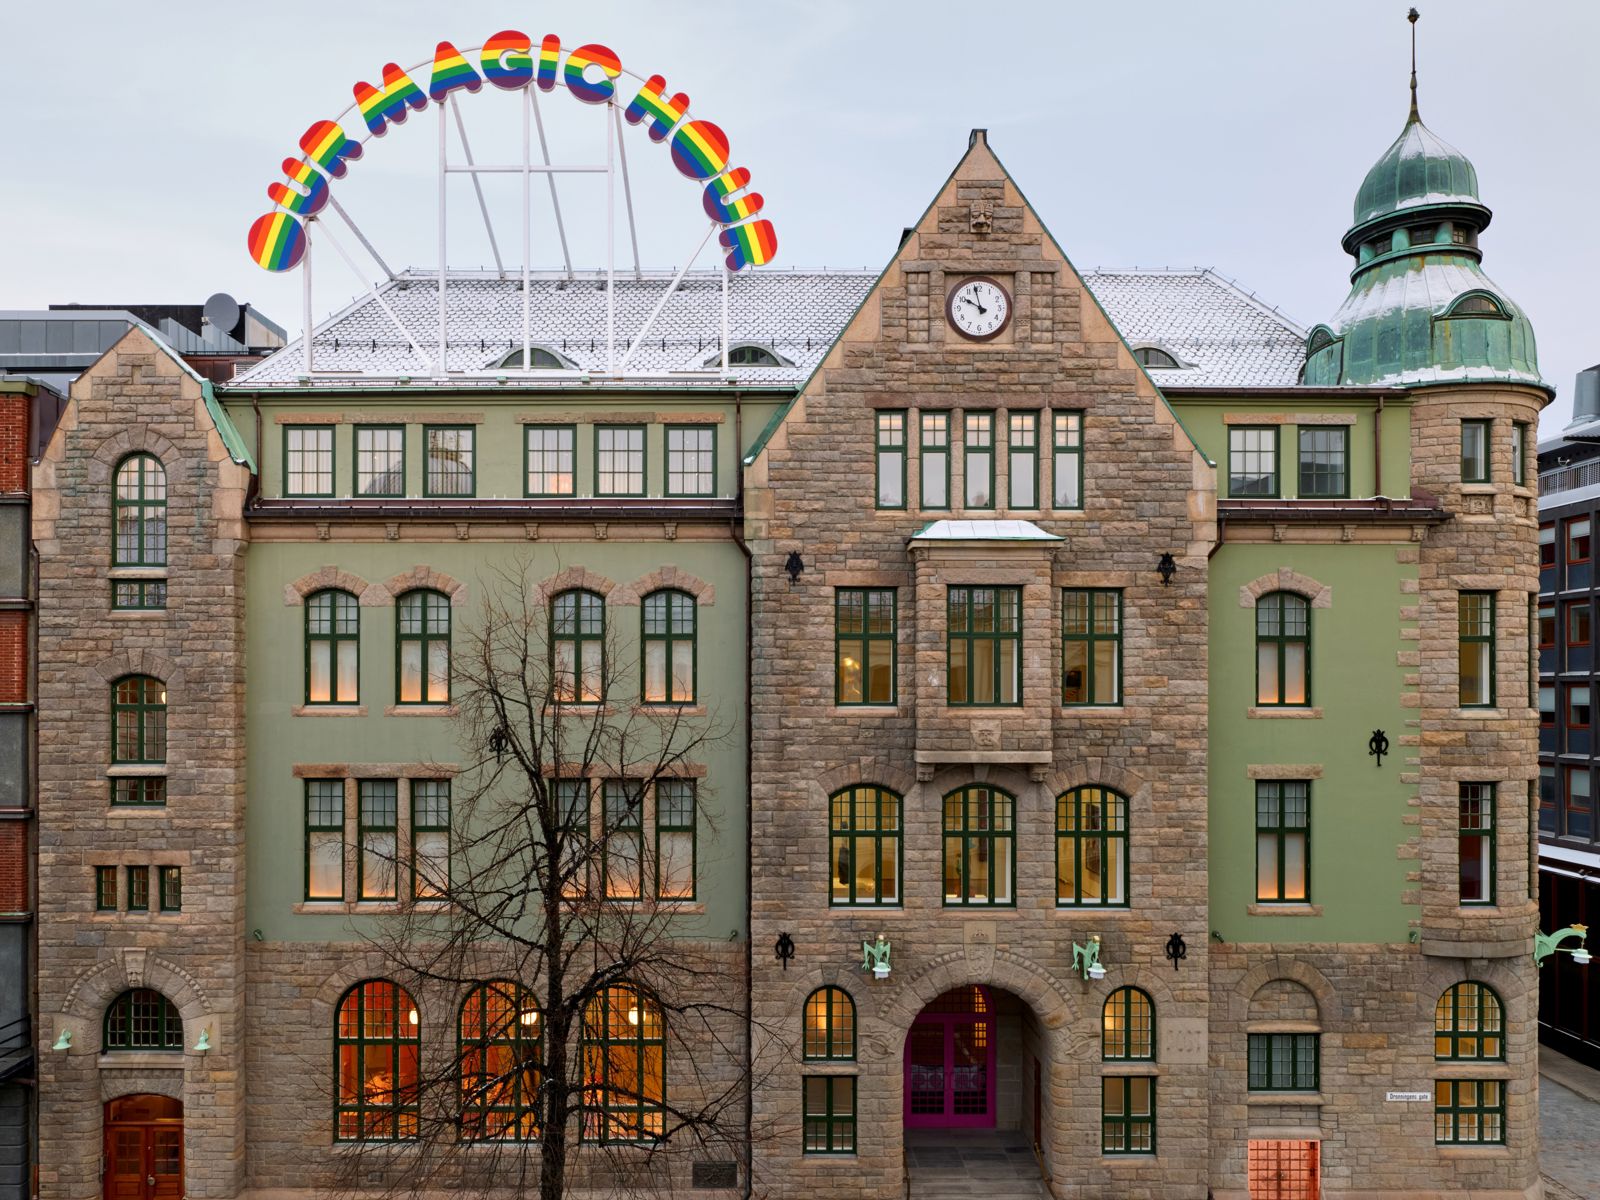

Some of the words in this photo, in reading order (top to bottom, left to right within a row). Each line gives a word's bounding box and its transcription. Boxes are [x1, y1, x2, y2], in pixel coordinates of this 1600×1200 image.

[247, 119, 364, 272] OUR
[352, 29, 623, 138] MAGIC
[624, 74, 778, 272] HOUR
